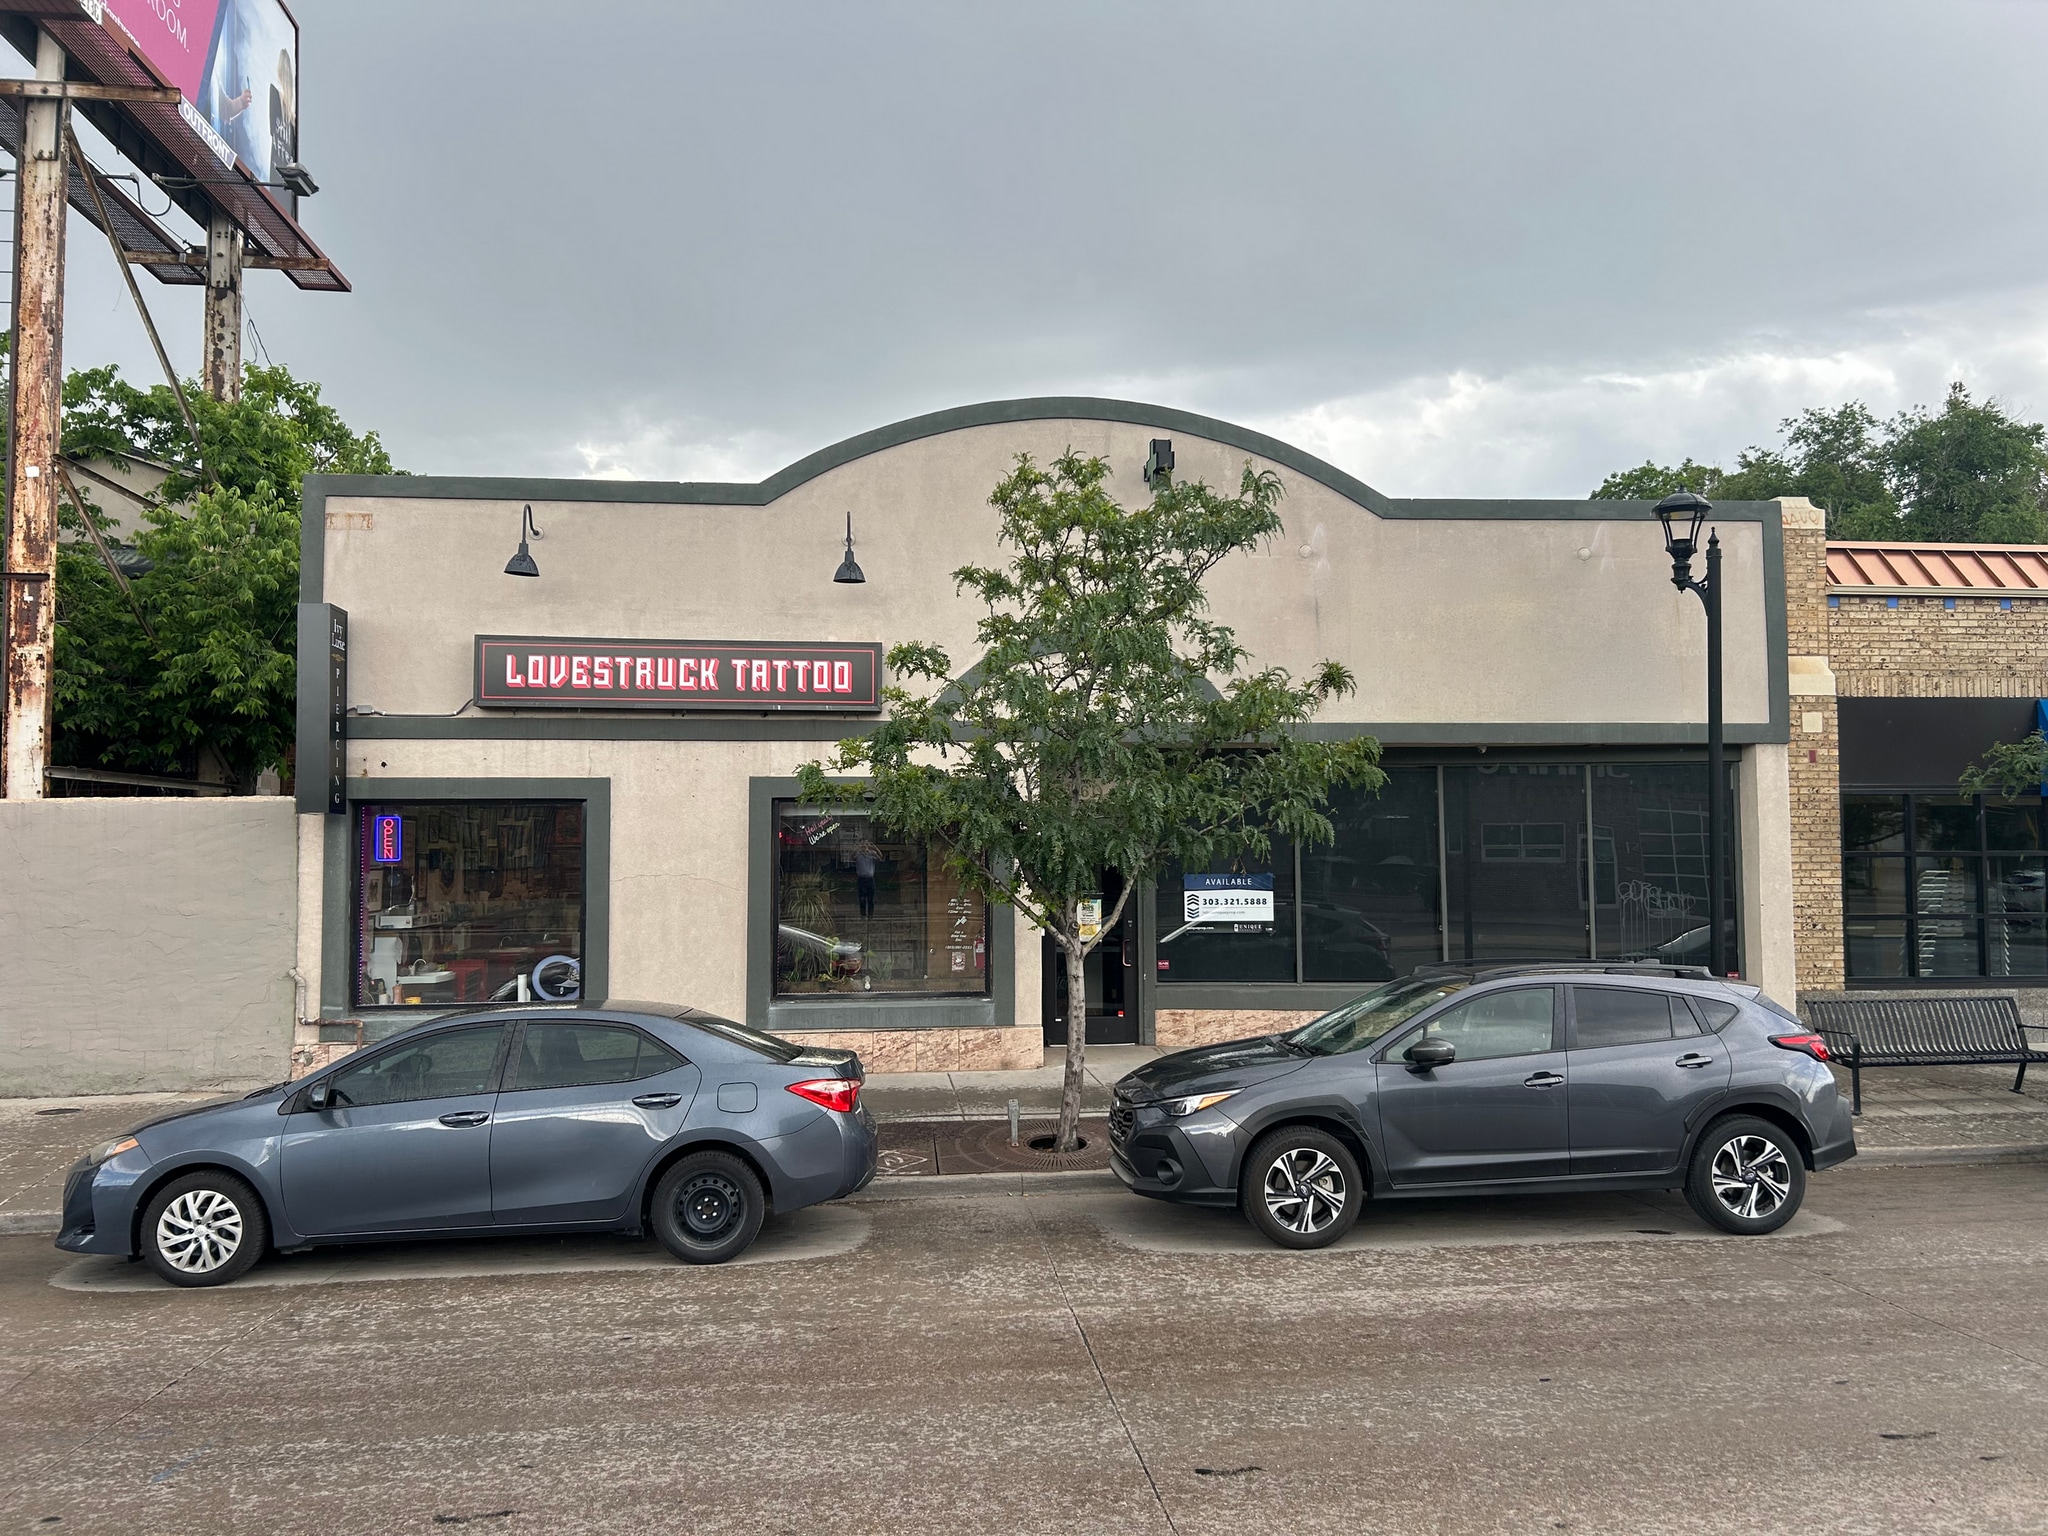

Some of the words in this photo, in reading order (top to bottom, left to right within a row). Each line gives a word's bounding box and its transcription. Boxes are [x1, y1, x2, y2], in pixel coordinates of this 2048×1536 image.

[183, 102, 231, 161] OUTFRONT
[505, 653, 721, 691] LOVESTRUCK
[731, 658, 853, 693] TATTOO
[383, 818, 394, 859] OPEN
[1202, 898, 1268, 906] 303.321.5888
[1205, 878, 1252, 886] AVAILABLE
